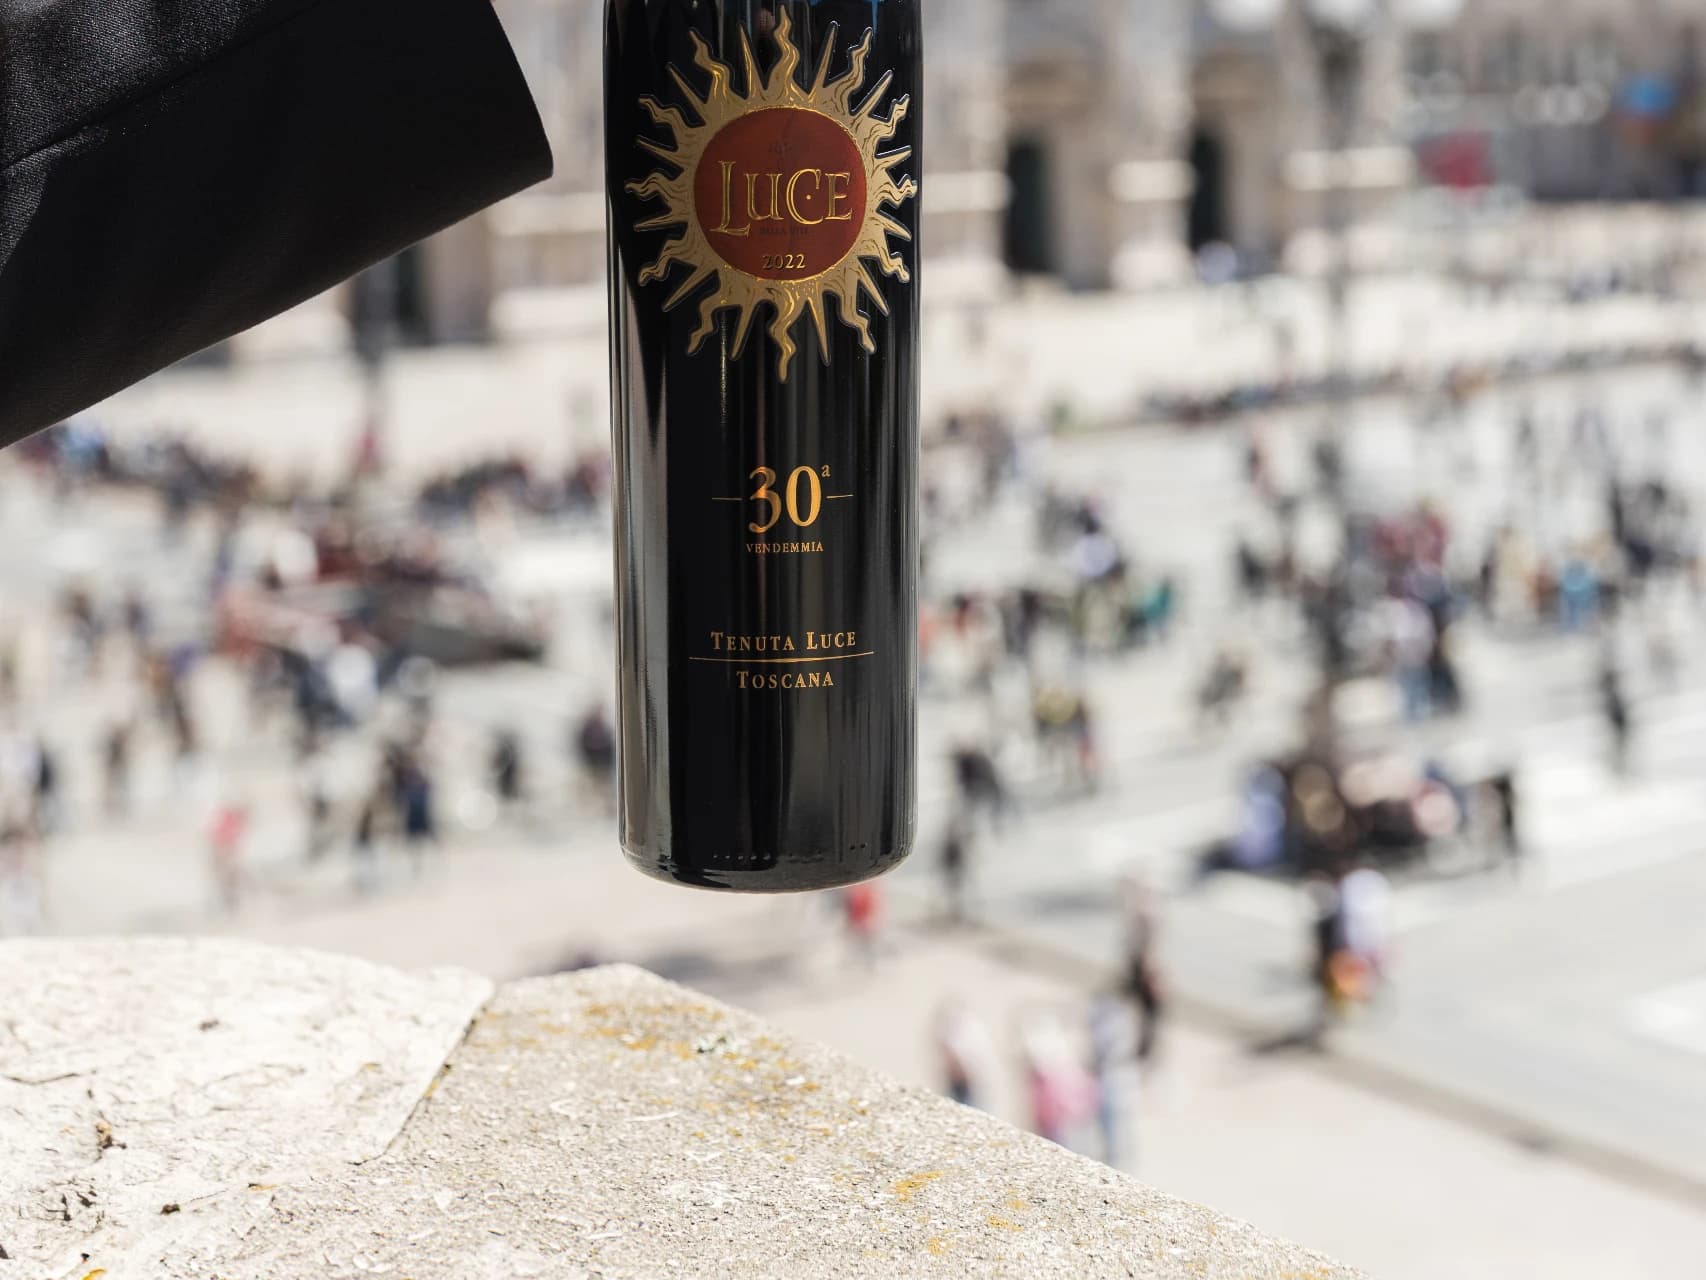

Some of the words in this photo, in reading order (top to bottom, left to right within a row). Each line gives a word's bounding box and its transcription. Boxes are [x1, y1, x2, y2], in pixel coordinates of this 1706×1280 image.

[709, 160, 853, 237] LUCE
[762, 252, 806, 270] 2022
[746, 541, 824, 553] VENDEMMIA
[710, 631, 795, 651] TENUTA
[806, 631, 856, 650] LUCE
[736, 671, 834, 689] TOSCANA
